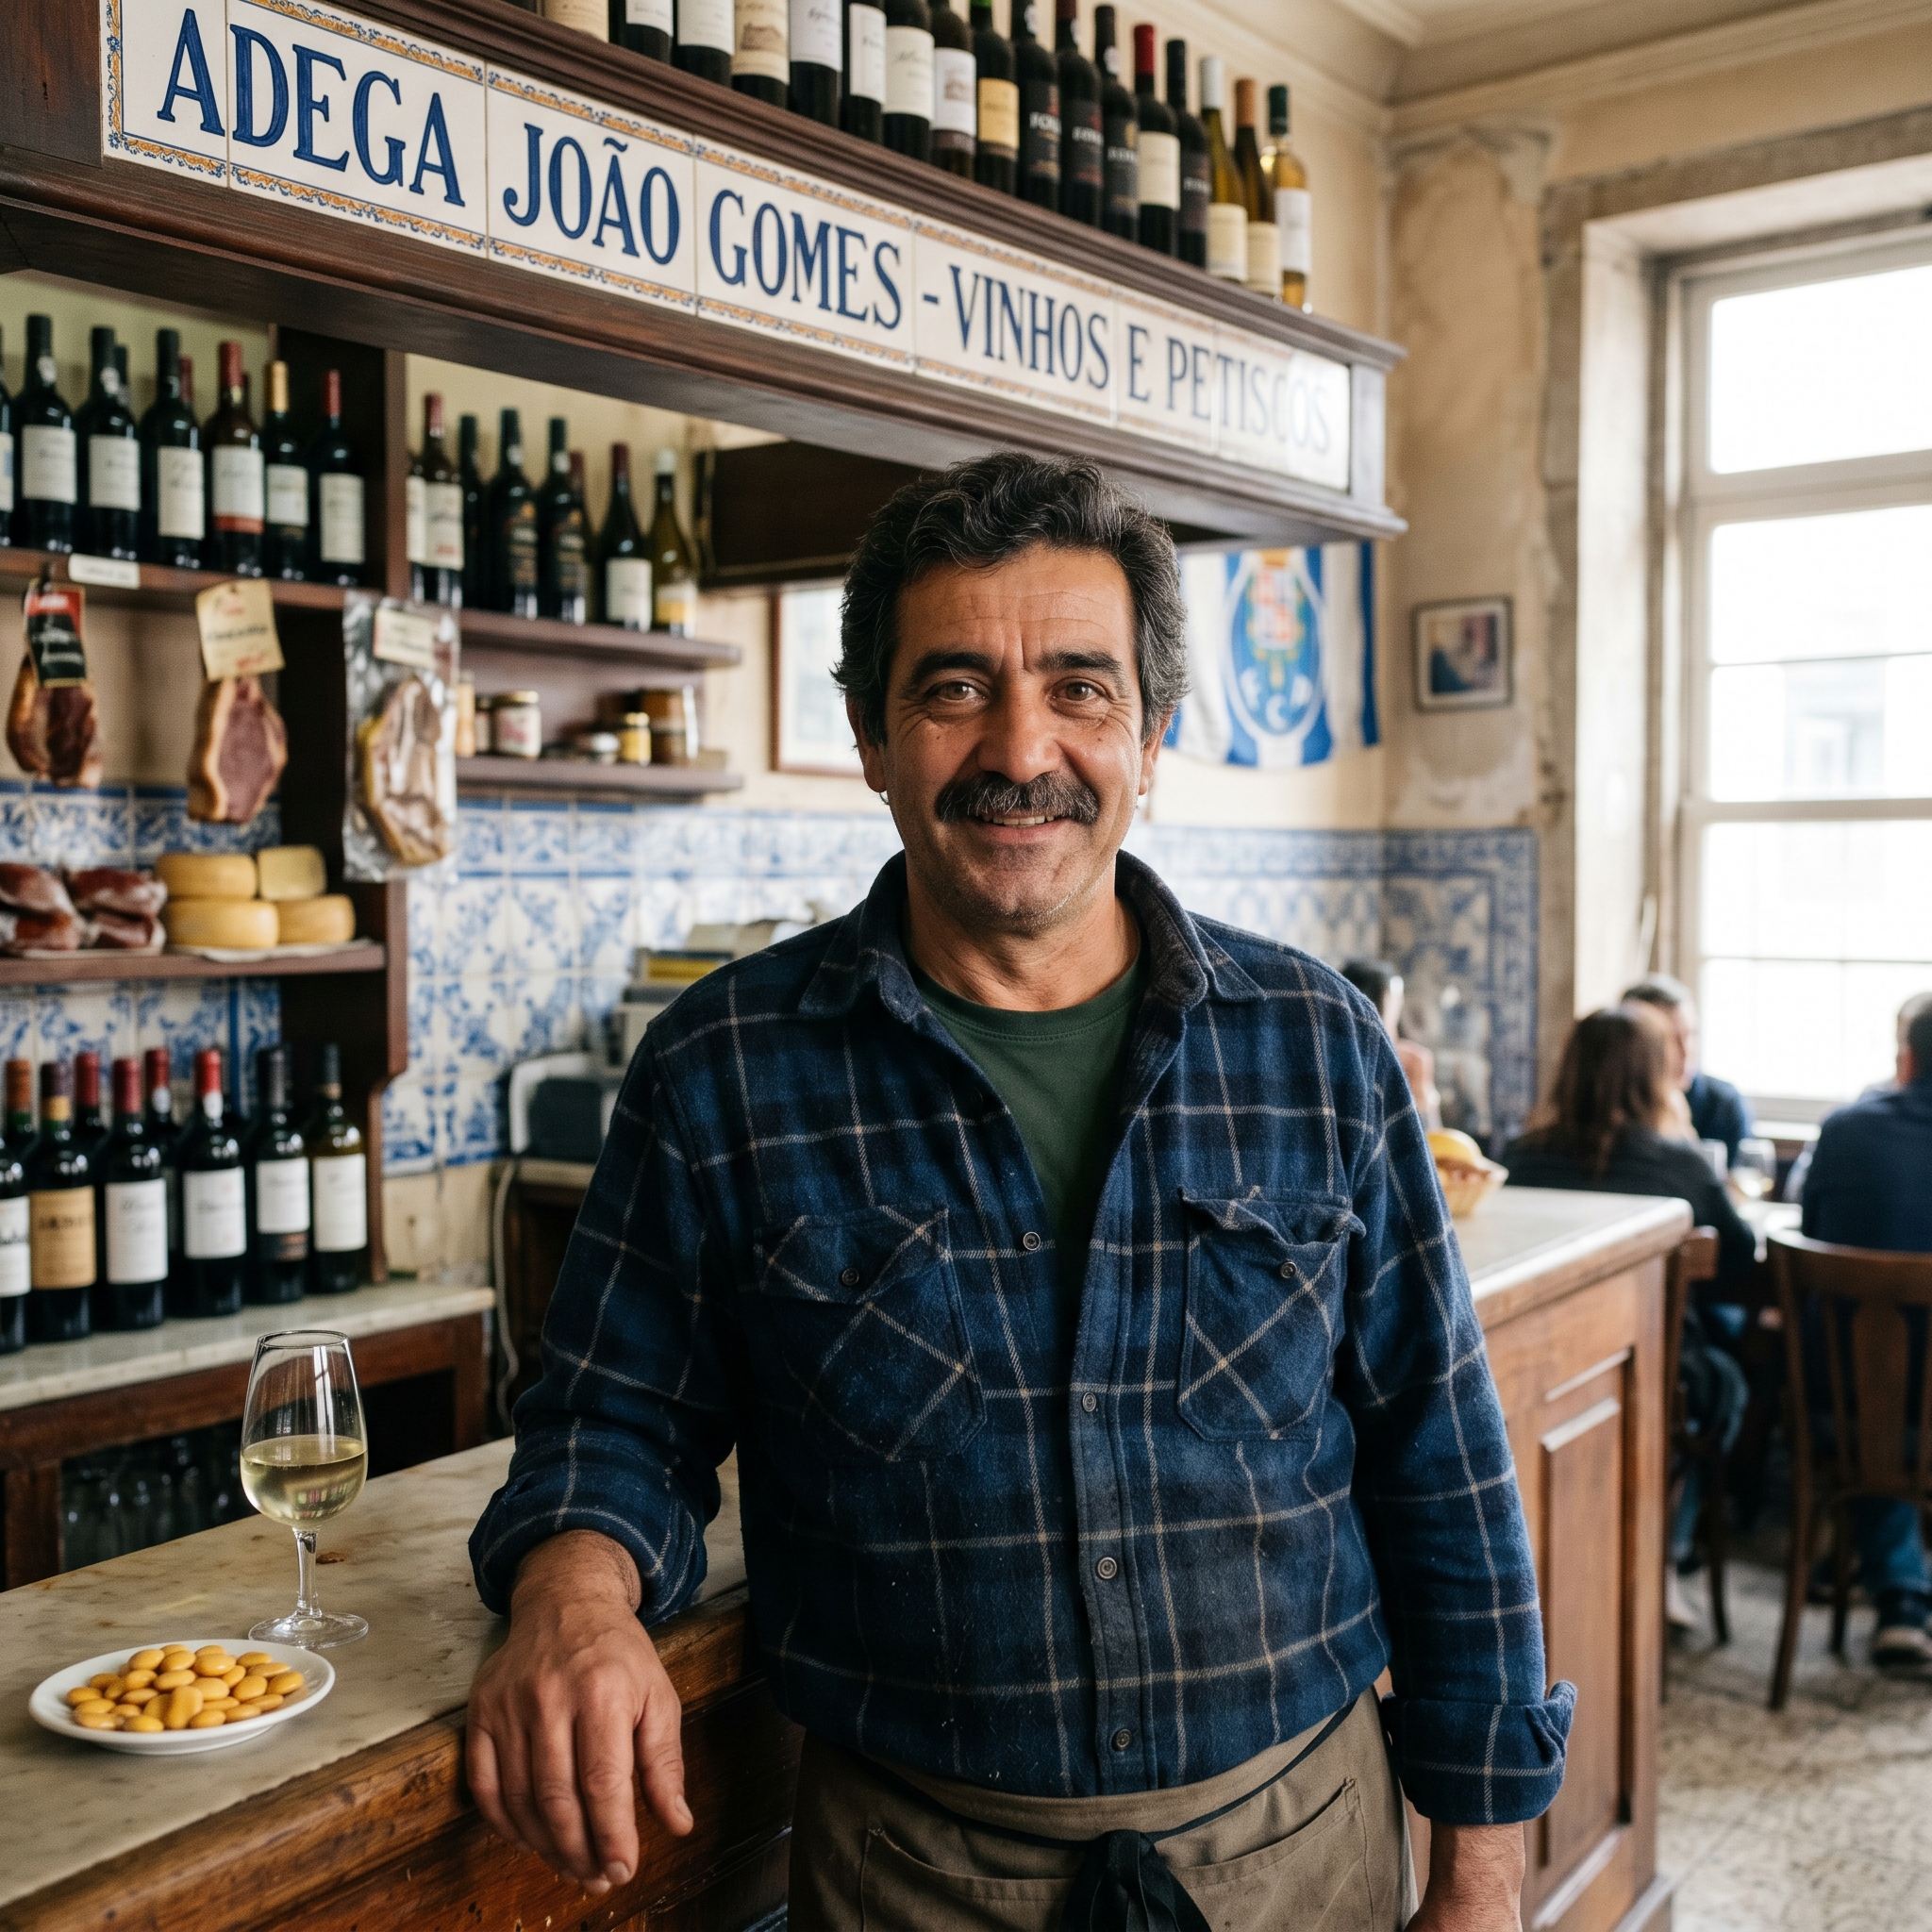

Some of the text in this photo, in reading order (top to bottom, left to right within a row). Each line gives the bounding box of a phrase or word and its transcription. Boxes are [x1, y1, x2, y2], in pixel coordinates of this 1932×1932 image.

[157, 8, 465, 208] ADEGA
[502, 123, 681, 266] JOÃO
[708, 190, 902, 330] GOMES
[948, 265, 1109, 390] VINHOS
[1127, 323, 1150, 403] E
[1166, 336, 1331, 454] PETISCOS
